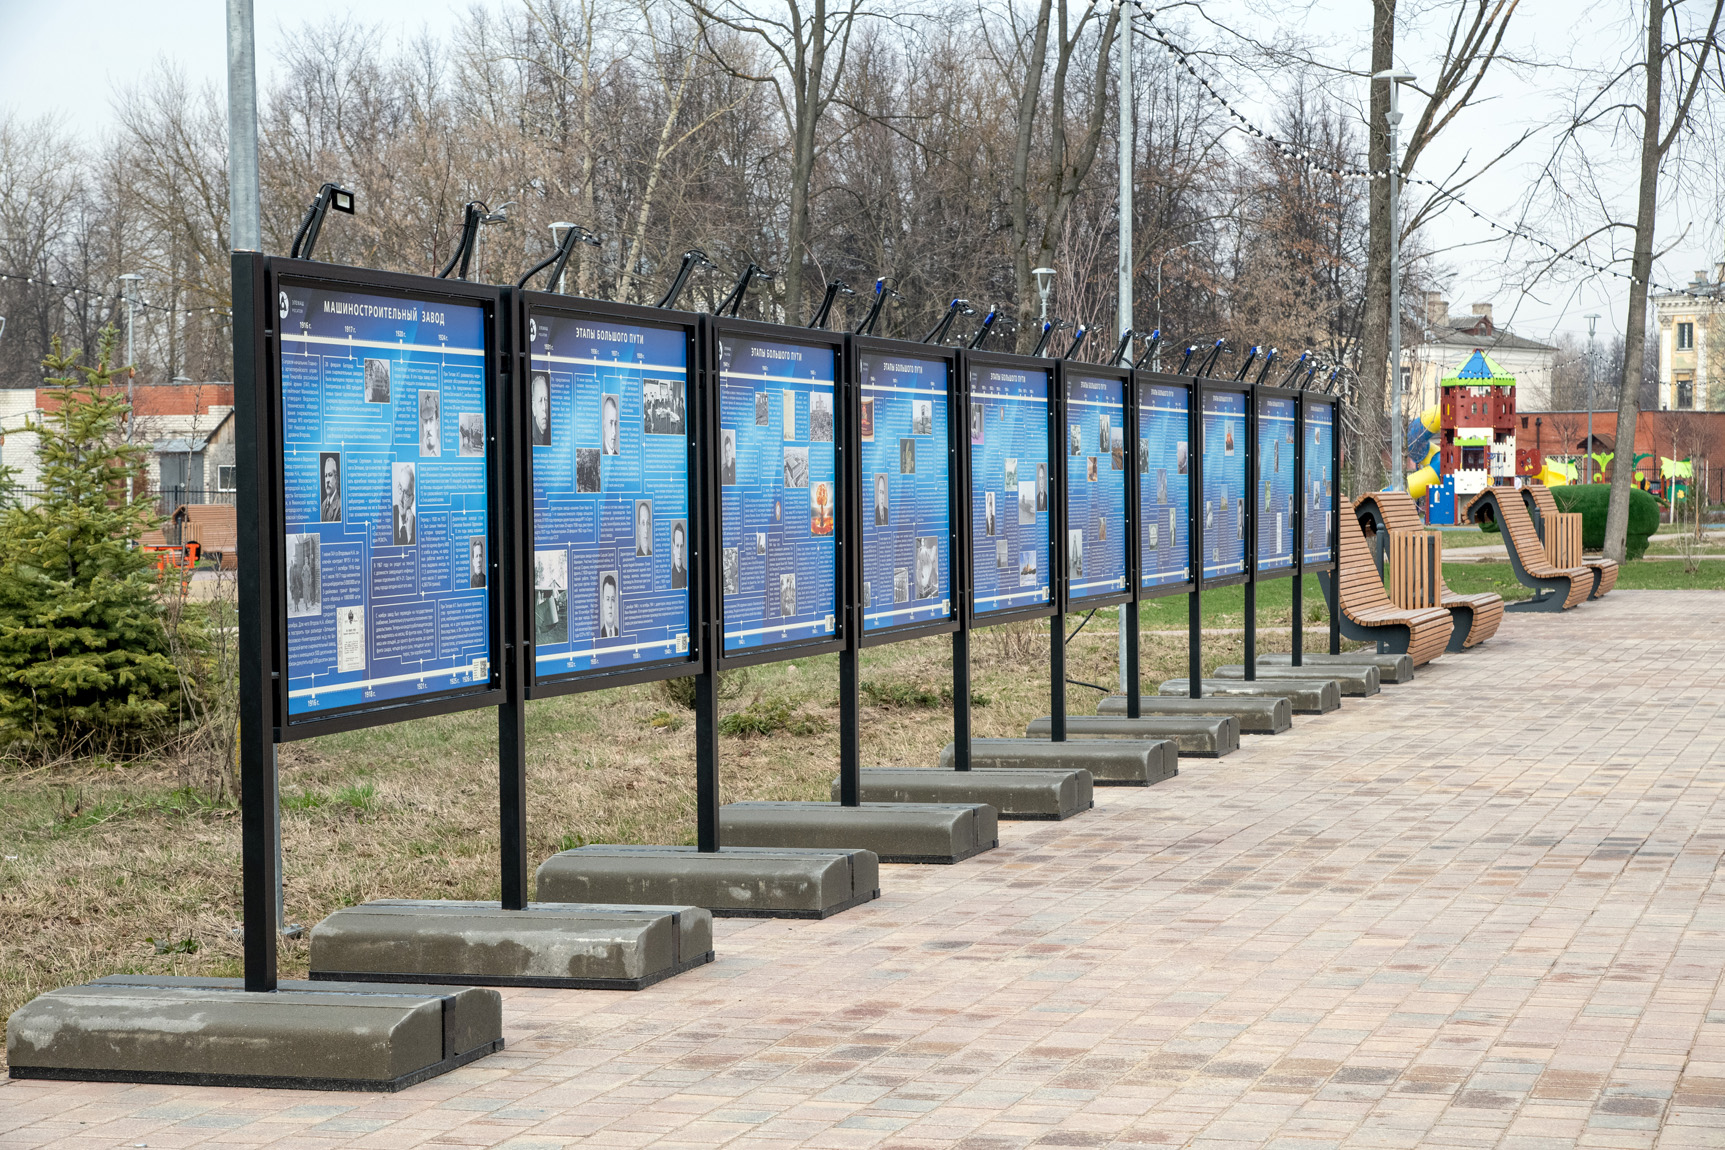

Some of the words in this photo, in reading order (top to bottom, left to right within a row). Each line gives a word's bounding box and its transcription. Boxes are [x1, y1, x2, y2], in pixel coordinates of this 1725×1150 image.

[324, 300, 418, 322] МАШИНОСТРОИТЕЛЬНЫЙ
[422, 310, 445, 326] ЗАВОД
[300, 321, 308, 329] 1916
[576, 327, 596, 340] ЭТАПЫ
[597, 330, 628, 343] БОЛЬШОГО
[630, 333, 644, 344] ПУТИ
